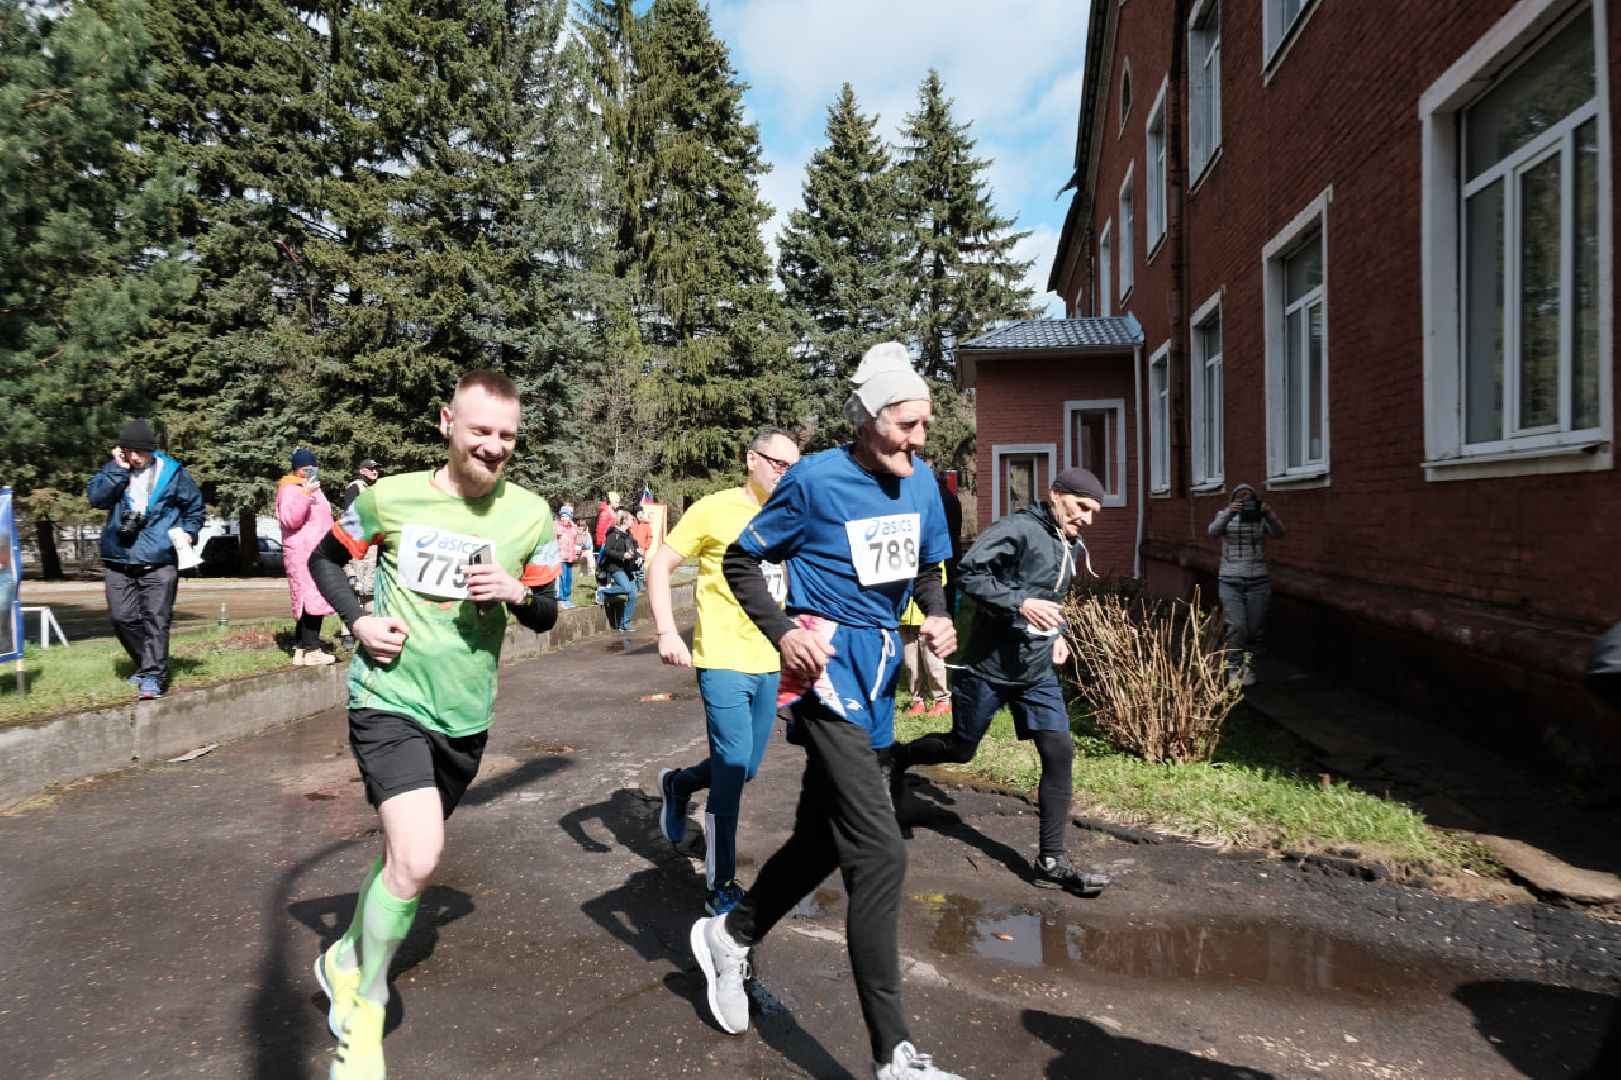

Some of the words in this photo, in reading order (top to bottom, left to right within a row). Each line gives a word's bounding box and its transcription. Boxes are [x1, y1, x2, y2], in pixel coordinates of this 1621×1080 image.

[881, 519, 914, 536] asics
[416, 551, 468, 589] 775
[868, 537, 917, 574] 788
